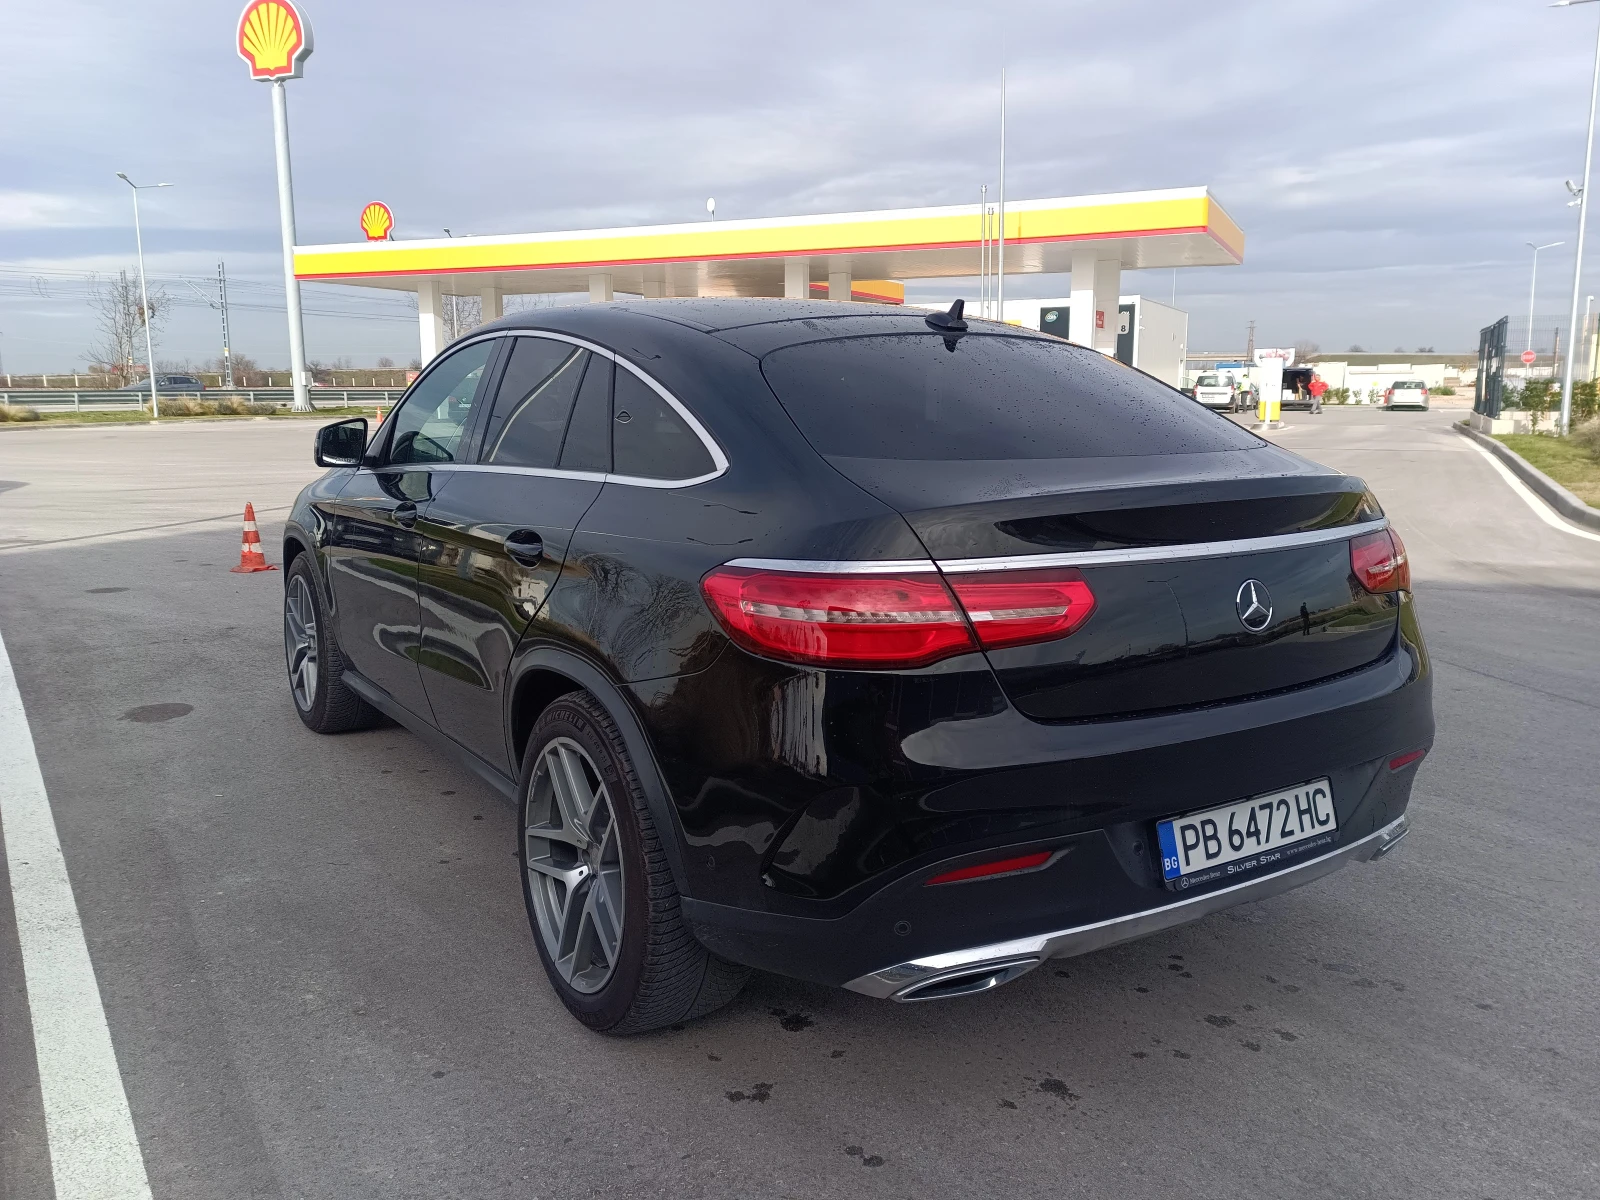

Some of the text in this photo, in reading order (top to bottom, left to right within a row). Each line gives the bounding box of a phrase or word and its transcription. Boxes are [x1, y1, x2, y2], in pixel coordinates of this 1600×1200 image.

[546, 710, 585, 729] MICHELIN
[1180, 787, 1331, 867] PB 6472 HC
[1164, 856, 1178, 871] BG
[1227, 853, 1281, 874] SILVER STAR
